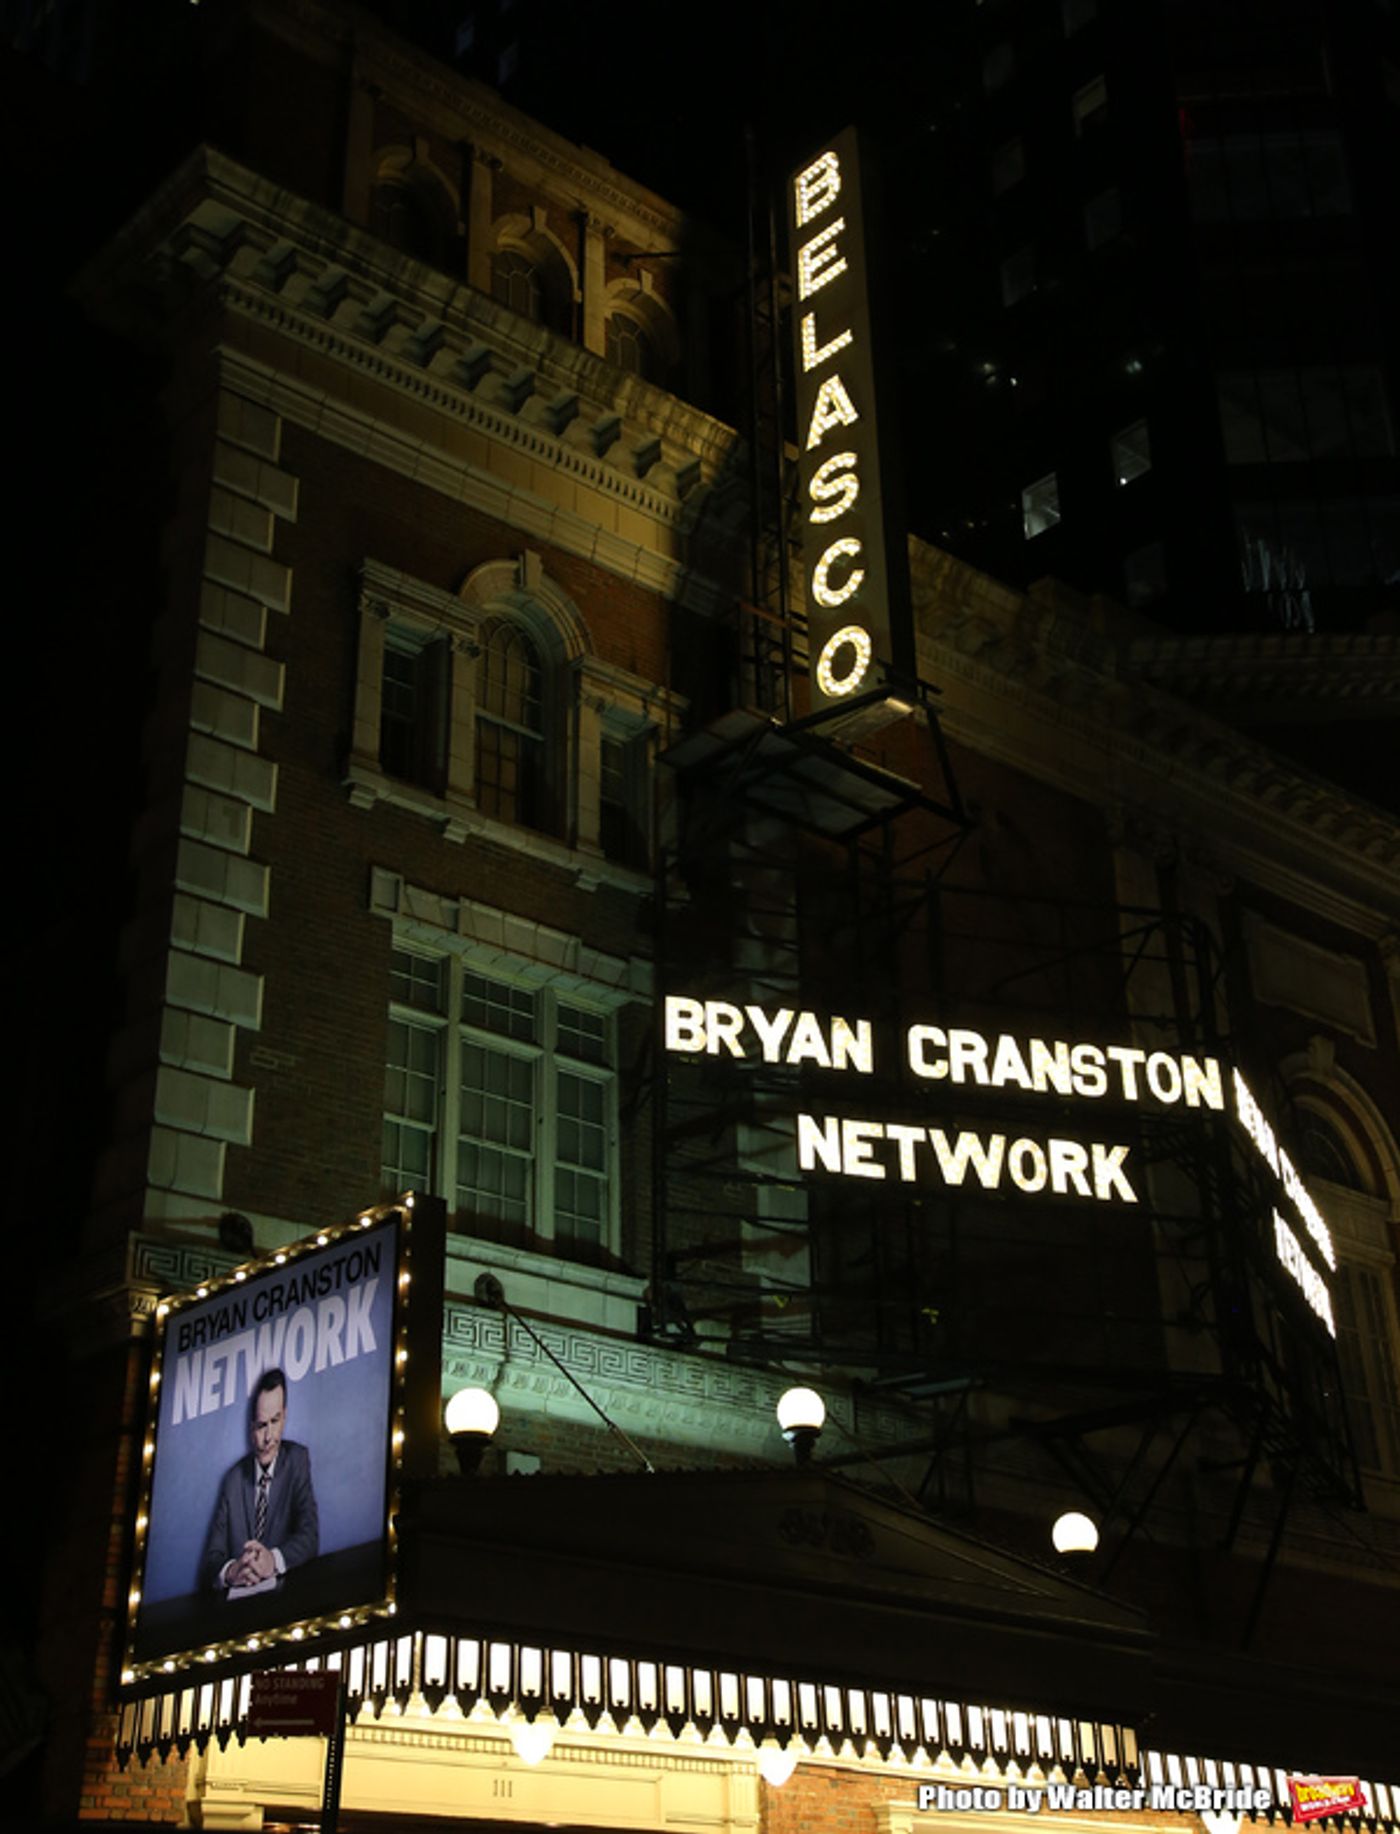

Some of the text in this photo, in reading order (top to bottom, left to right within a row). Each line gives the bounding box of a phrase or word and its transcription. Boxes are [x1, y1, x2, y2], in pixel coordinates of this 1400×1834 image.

[795, 151, 872, 697] BELASCO
[665, 995, 1225, 1110] BRYAN CRANSTON
[797, 1113, 1138, 1203] NETWORK
[172, 1278, 378, 1425] NETWORK
[179, 1244, 381, 1352] BRYAN CRANSTON
